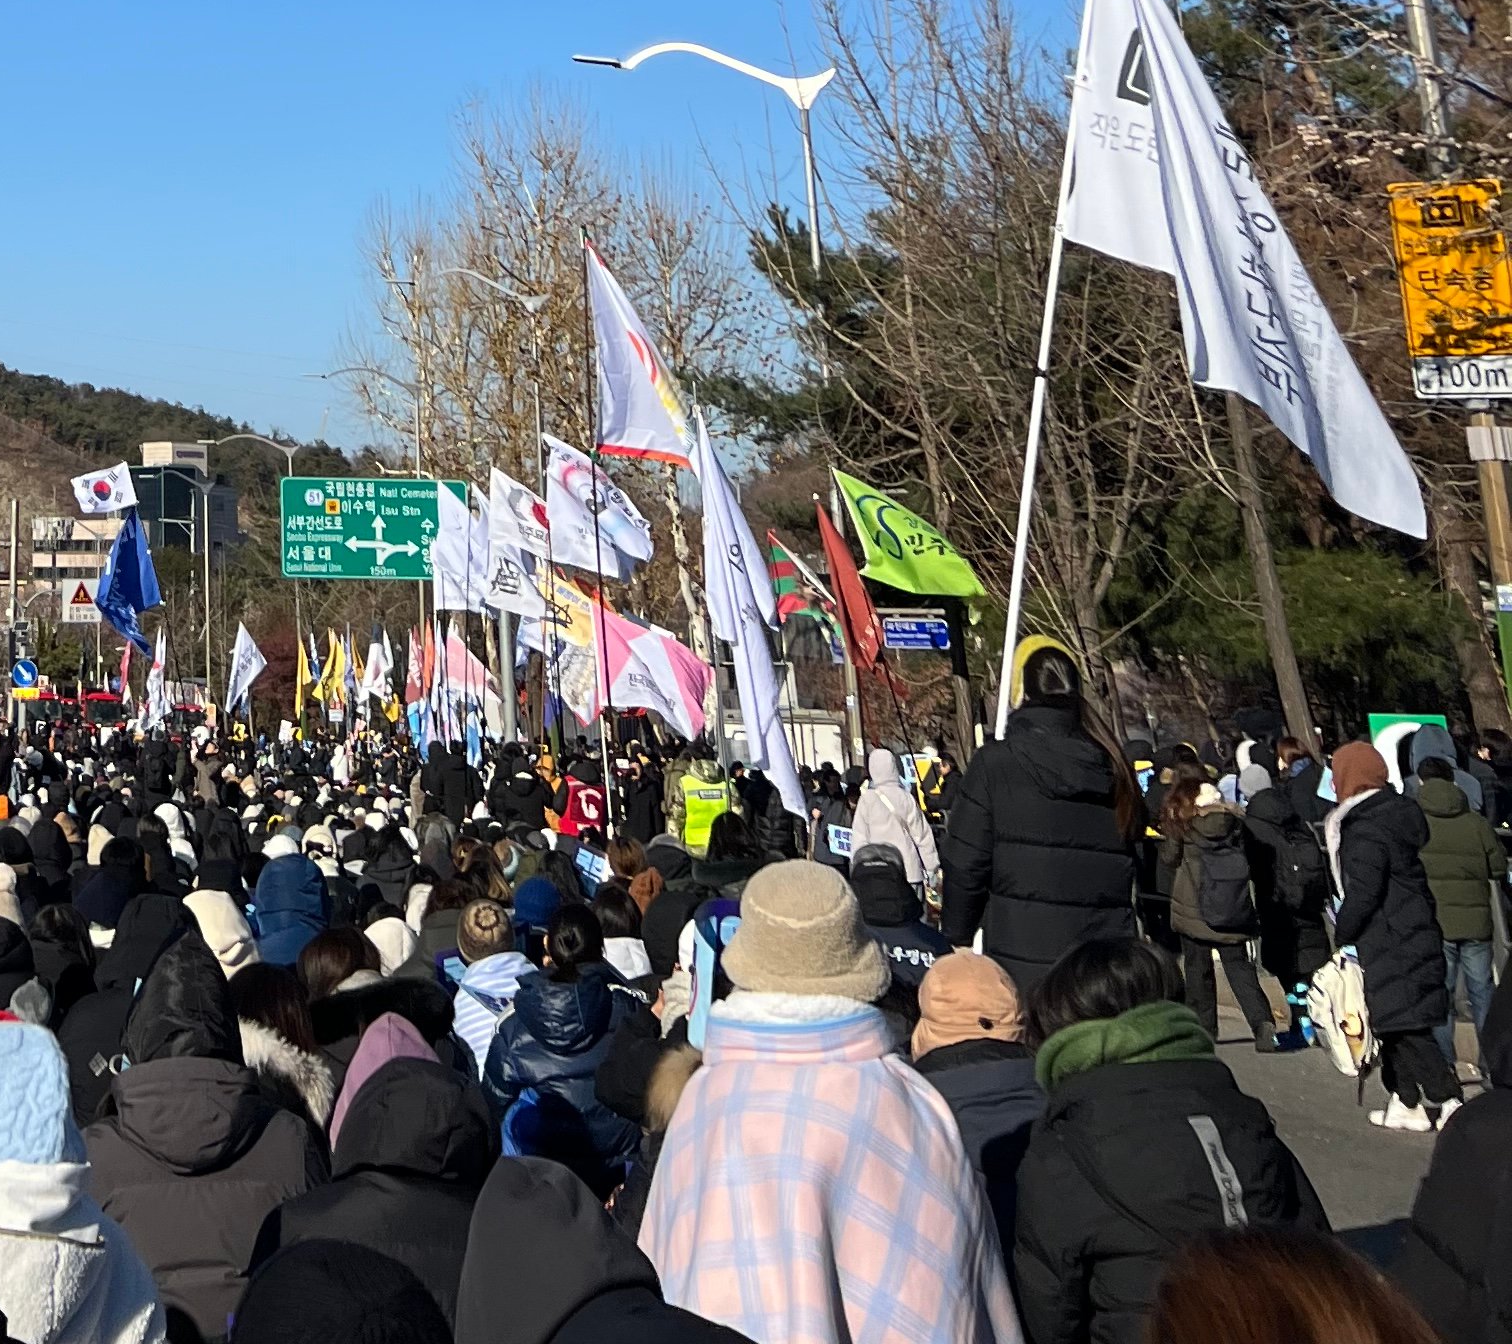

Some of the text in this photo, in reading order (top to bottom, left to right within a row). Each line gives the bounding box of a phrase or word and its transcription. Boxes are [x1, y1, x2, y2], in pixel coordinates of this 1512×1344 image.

[308, 491, 321, 503] 51
[341, 499, 377, 516] 이수역
[381, 505, 399, 516] Isu
[287, 515, 344, 531] 서부간선도로
[286, 545, 332, 562] 서울대
[370, 566, 397, 576] 150m
